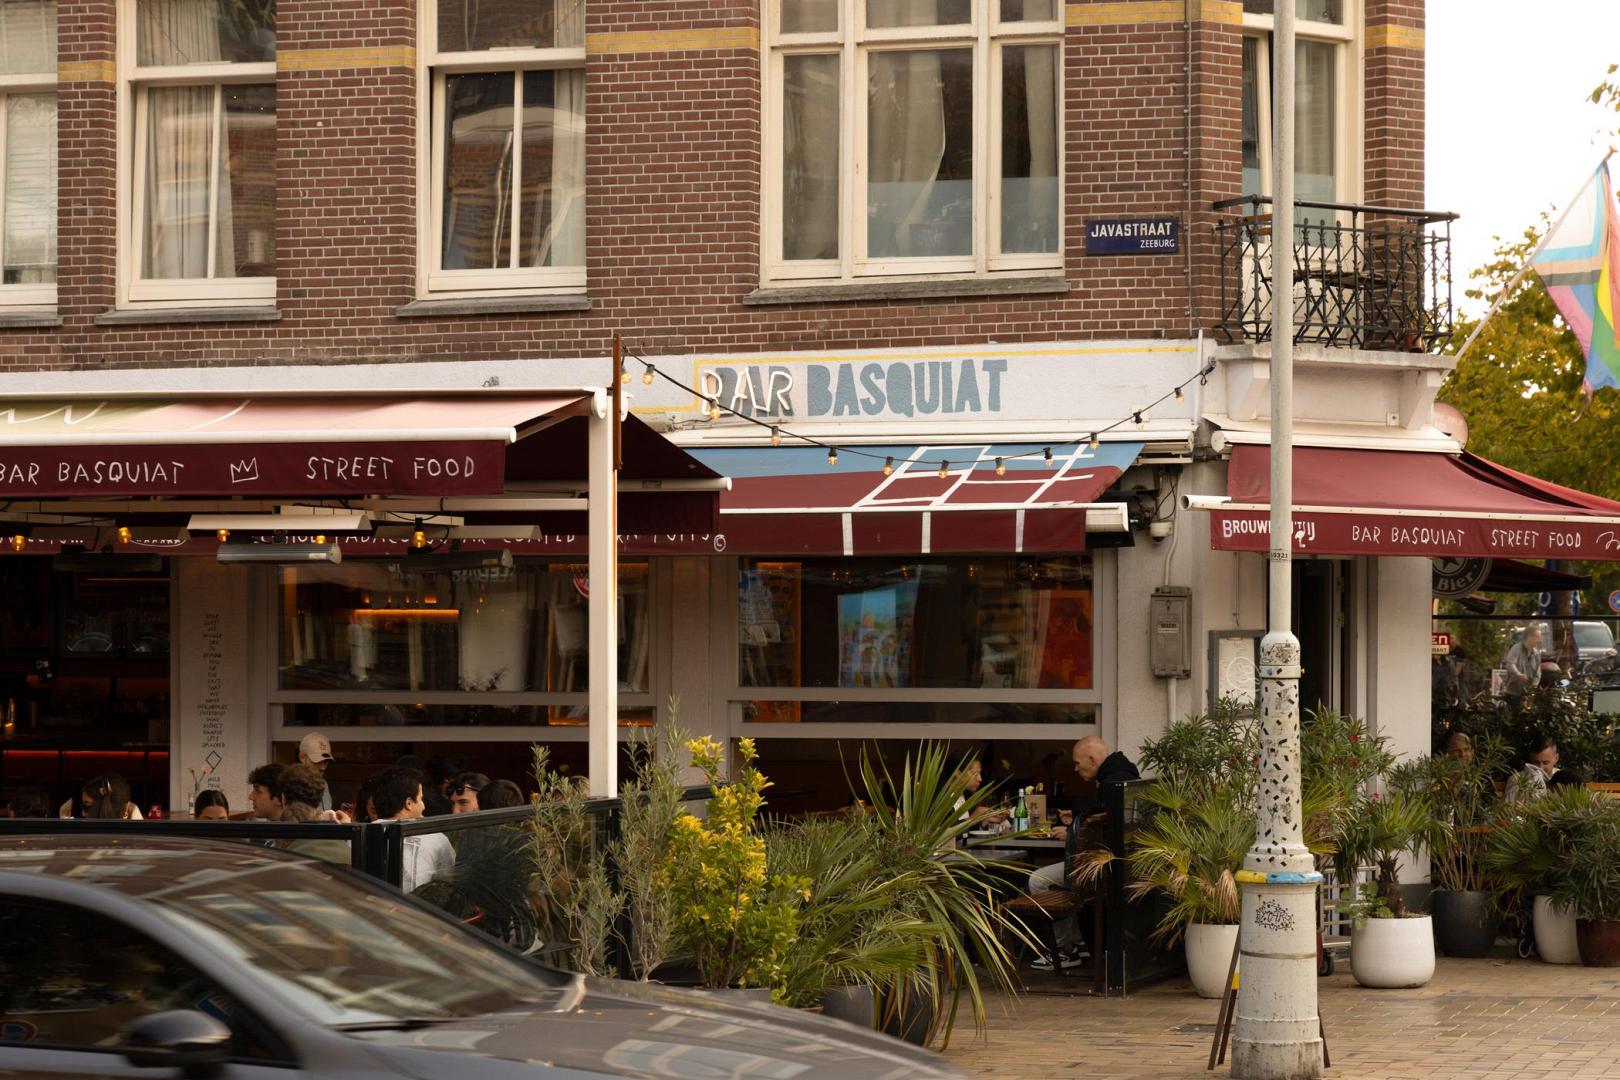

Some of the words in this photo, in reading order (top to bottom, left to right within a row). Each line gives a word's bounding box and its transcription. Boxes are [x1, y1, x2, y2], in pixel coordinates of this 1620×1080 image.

[1091, 222, 1172, 238] JAVASTRAAT
[1140, 239, 1175, 249] ZEEBURG
[701, 366, 794, 417] BAR
[807, 359, 1008, 418] BASQUIAT
[59, 461, 185, 484] BASQUIAT
[306, 456, 394, 480] STREET
[414, 456, 475, 480] FOOD
[1352, 525, 1381, 545] BAR
[1391, 527, 1465, 547] BASQUIAT
[1491, 529, 1540, 548] STREET
[1549, 532, 1581, 549] FOOD
[1436, 571, 1474, 592] Bier
